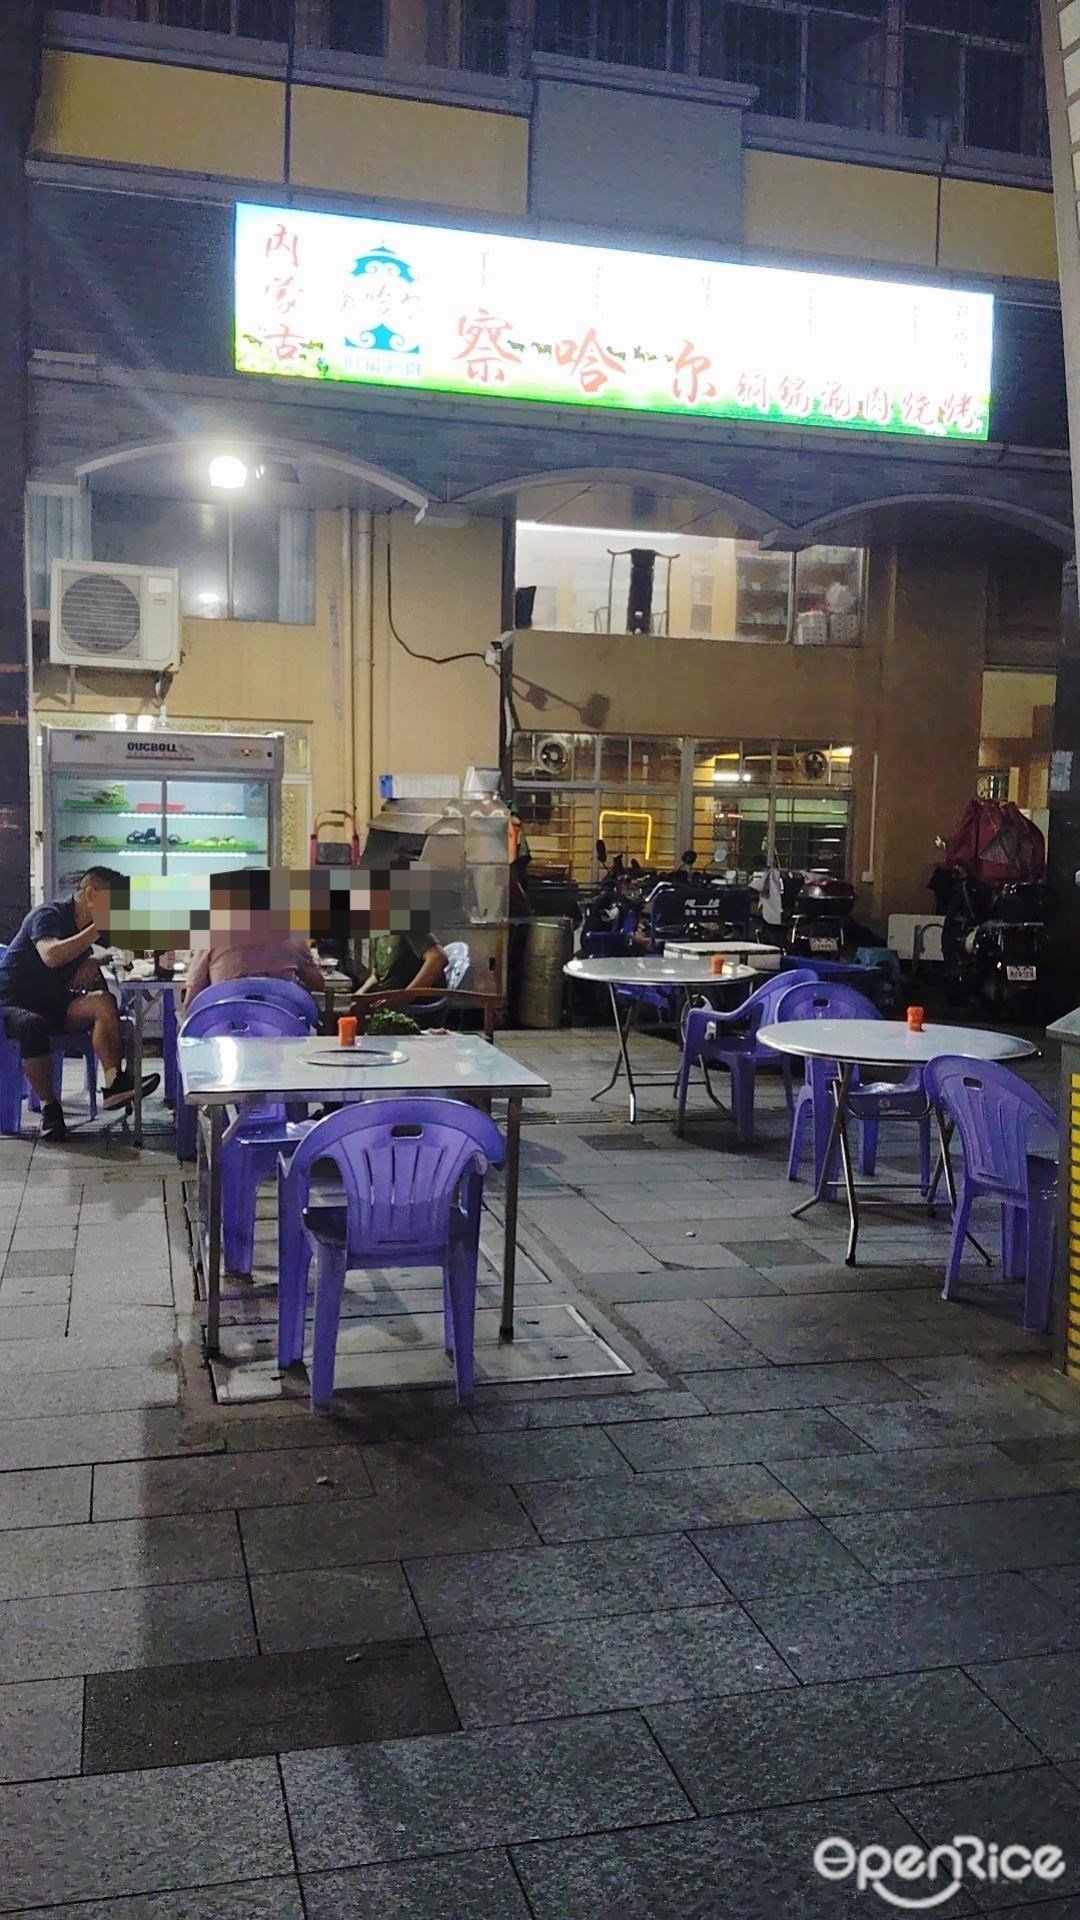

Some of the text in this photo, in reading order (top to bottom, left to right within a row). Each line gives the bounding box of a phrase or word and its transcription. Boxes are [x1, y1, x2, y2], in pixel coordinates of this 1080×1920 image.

[264, 223, 304, 361] 内蒙古
[452, 308, 716, 404] 察哈尔
